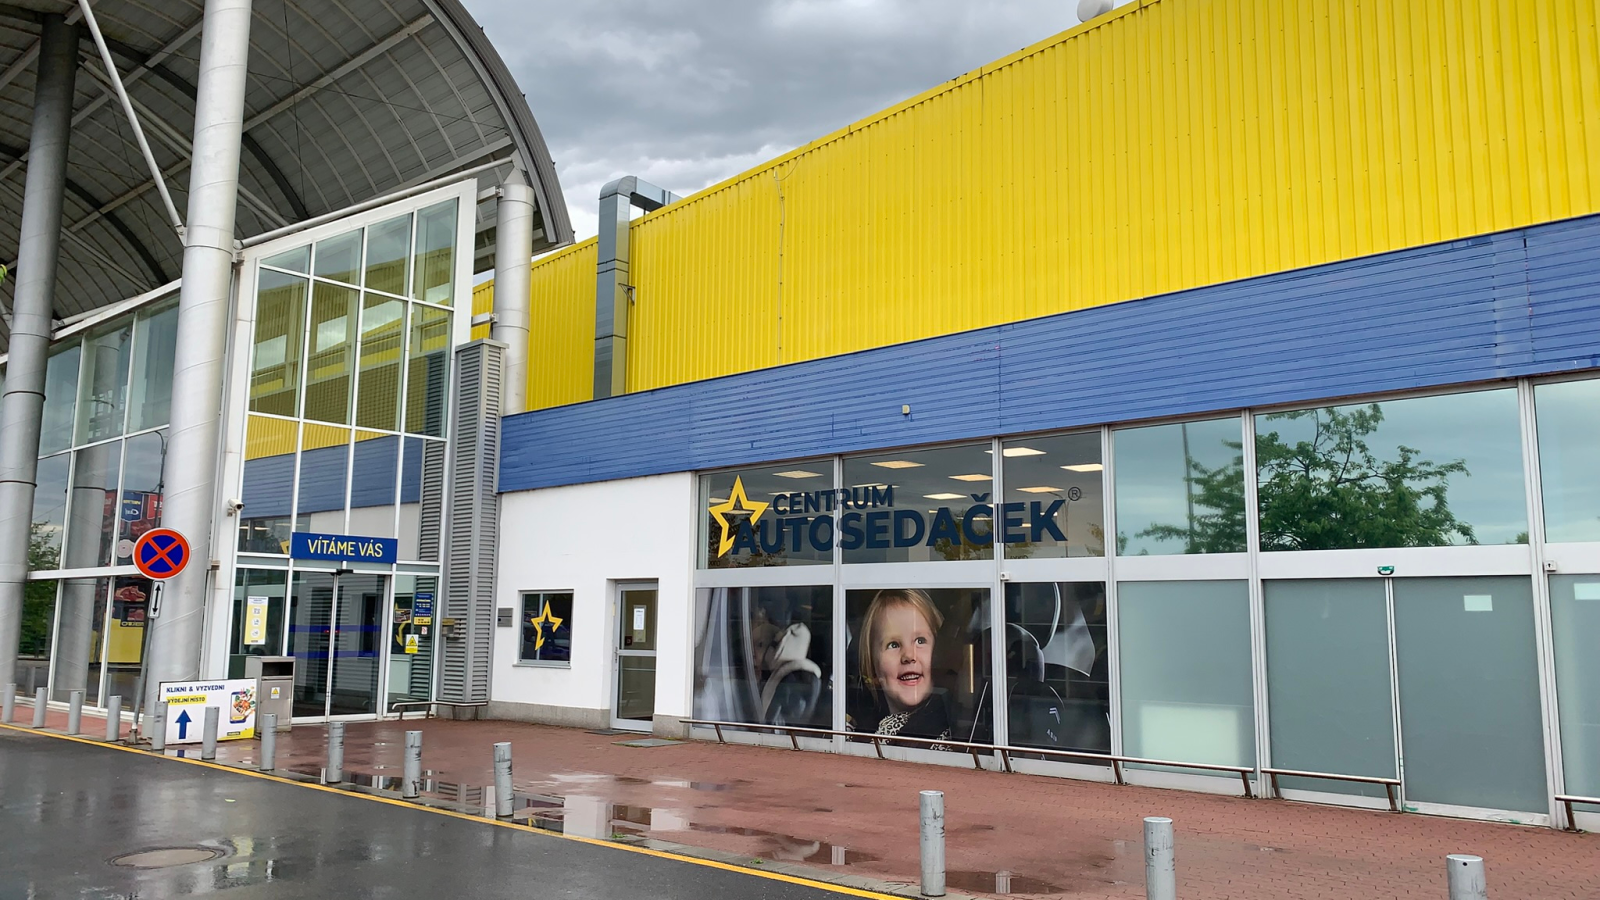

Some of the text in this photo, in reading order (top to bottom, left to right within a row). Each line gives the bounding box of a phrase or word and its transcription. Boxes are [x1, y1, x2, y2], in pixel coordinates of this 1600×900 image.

[773, 484, 893, 515] CENTRUM
[731, 492, 1068, 555] AUTOSEDAČEK
[307, 536, 383, 557] VÍTÁME VÁS
